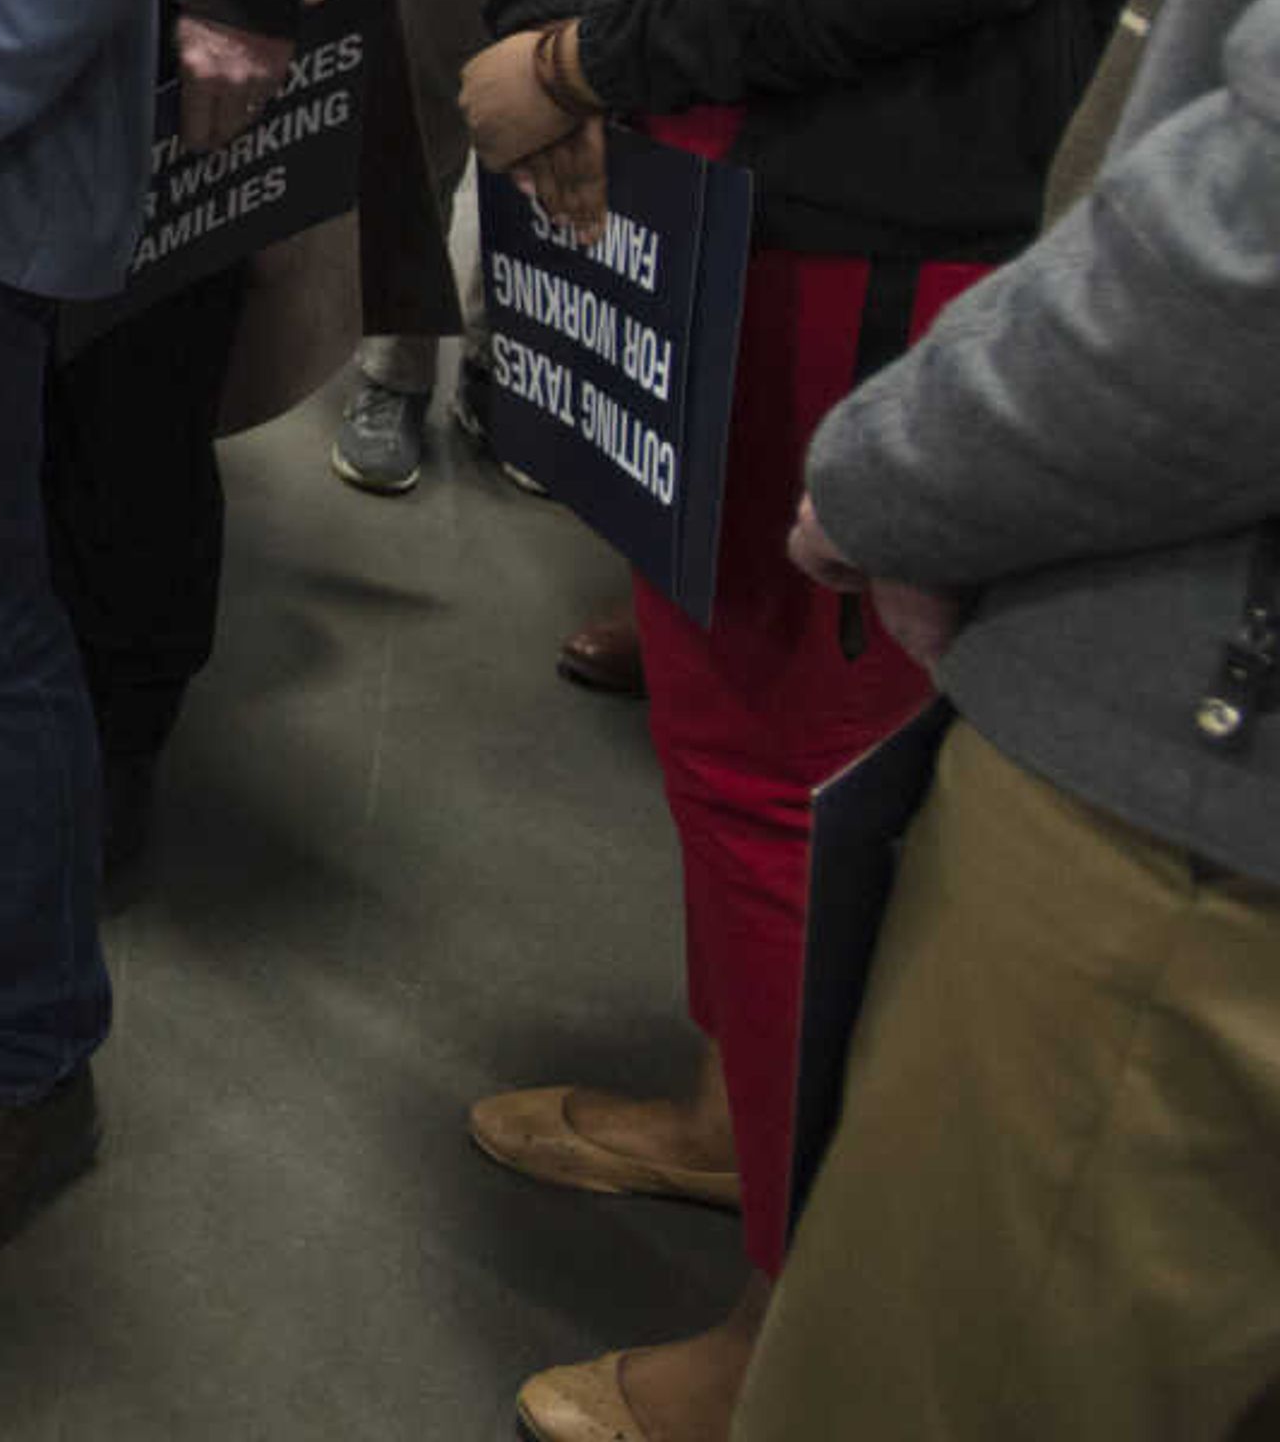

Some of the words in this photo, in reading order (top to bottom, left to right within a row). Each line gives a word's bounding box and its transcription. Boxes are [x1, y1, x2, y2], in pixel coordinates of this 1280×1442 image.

[170, 90, 350, 205] WORKING
[492, 253, 618, 365] WORKING
[624, 317, 672, 401] FOR
[493, 333, 575, 426] TAXES
[582, 381, 675, 506] CUTTING
